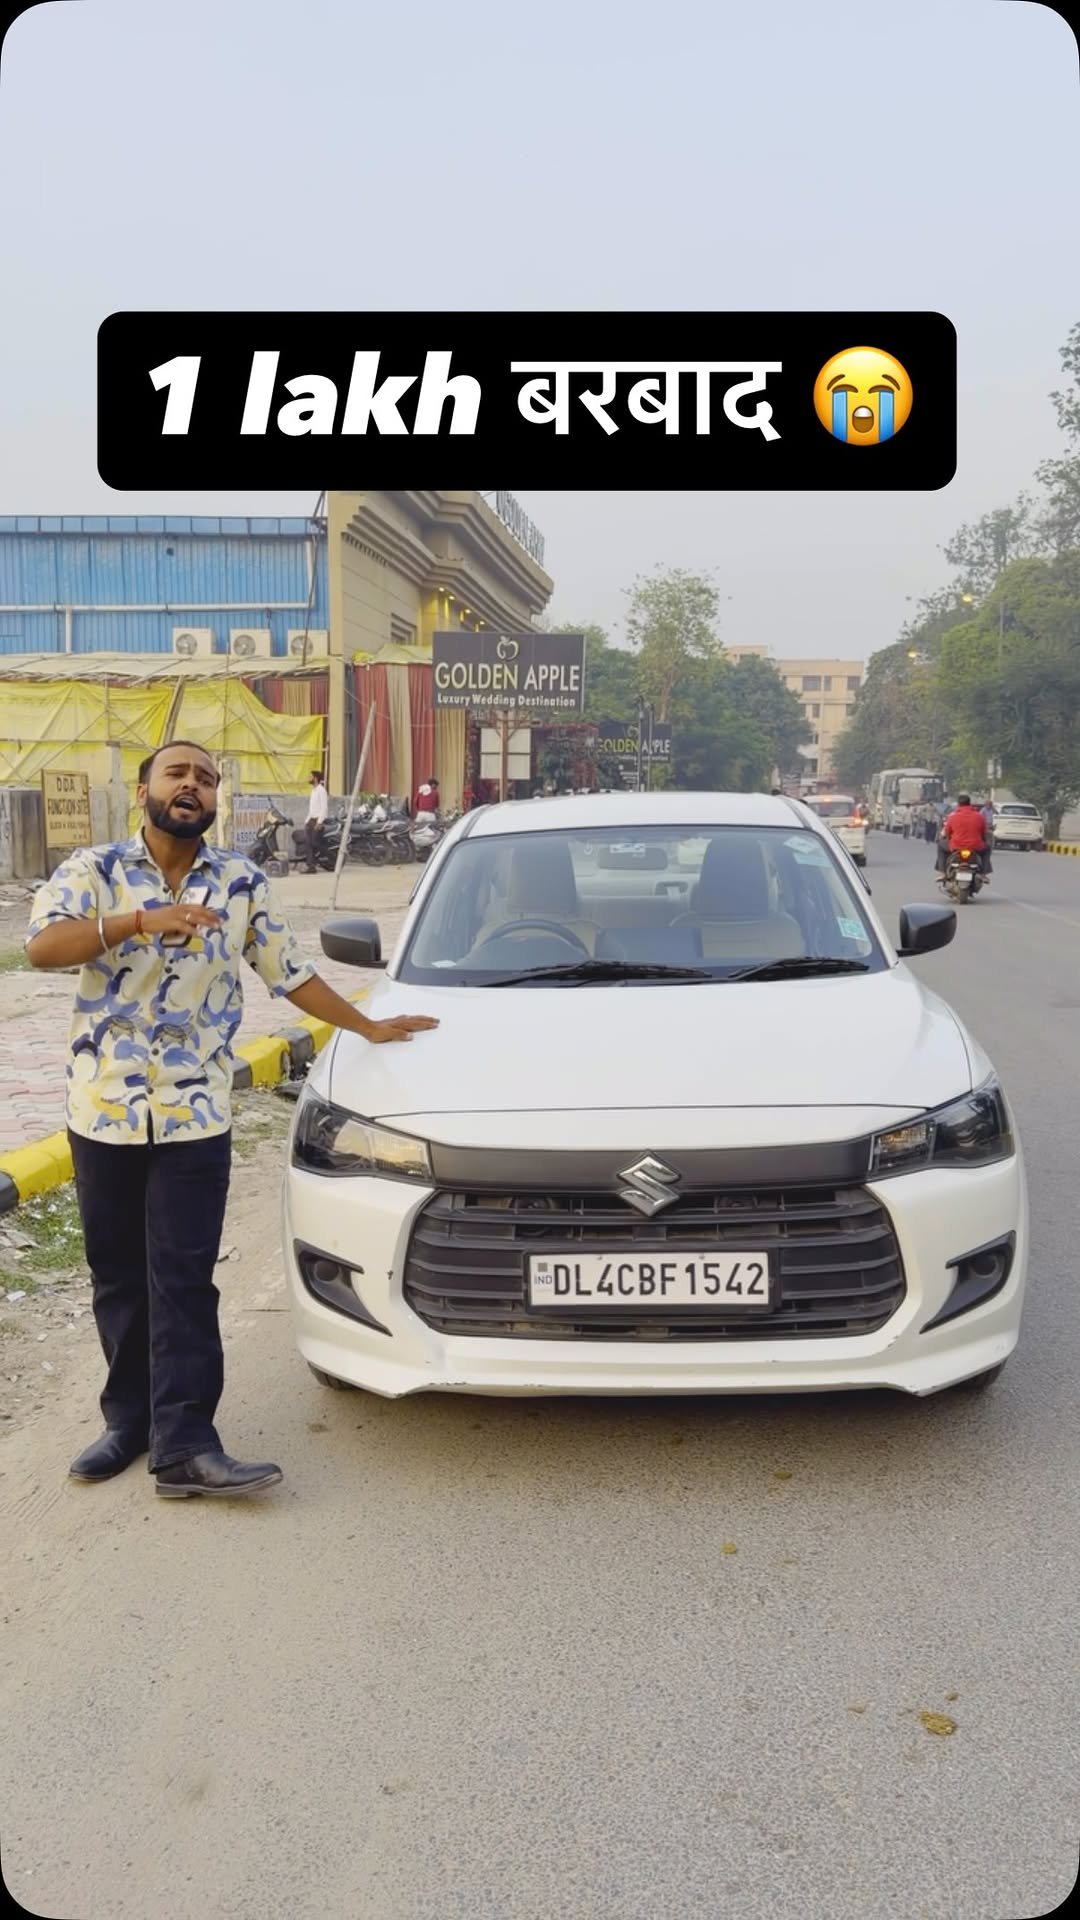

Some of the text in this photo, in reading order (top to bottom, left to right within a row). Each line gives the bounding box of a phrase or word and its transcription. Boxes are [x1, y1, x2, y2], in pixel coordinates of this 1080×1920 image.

[435, 662, 579, 691] GOLDEN APPLE
[438, 693, 576, 707] Luxury Wedding Destination
[534, 1275, 552, 1285] IND
[554, 1262, 764, 1296] DL4CBF1542
